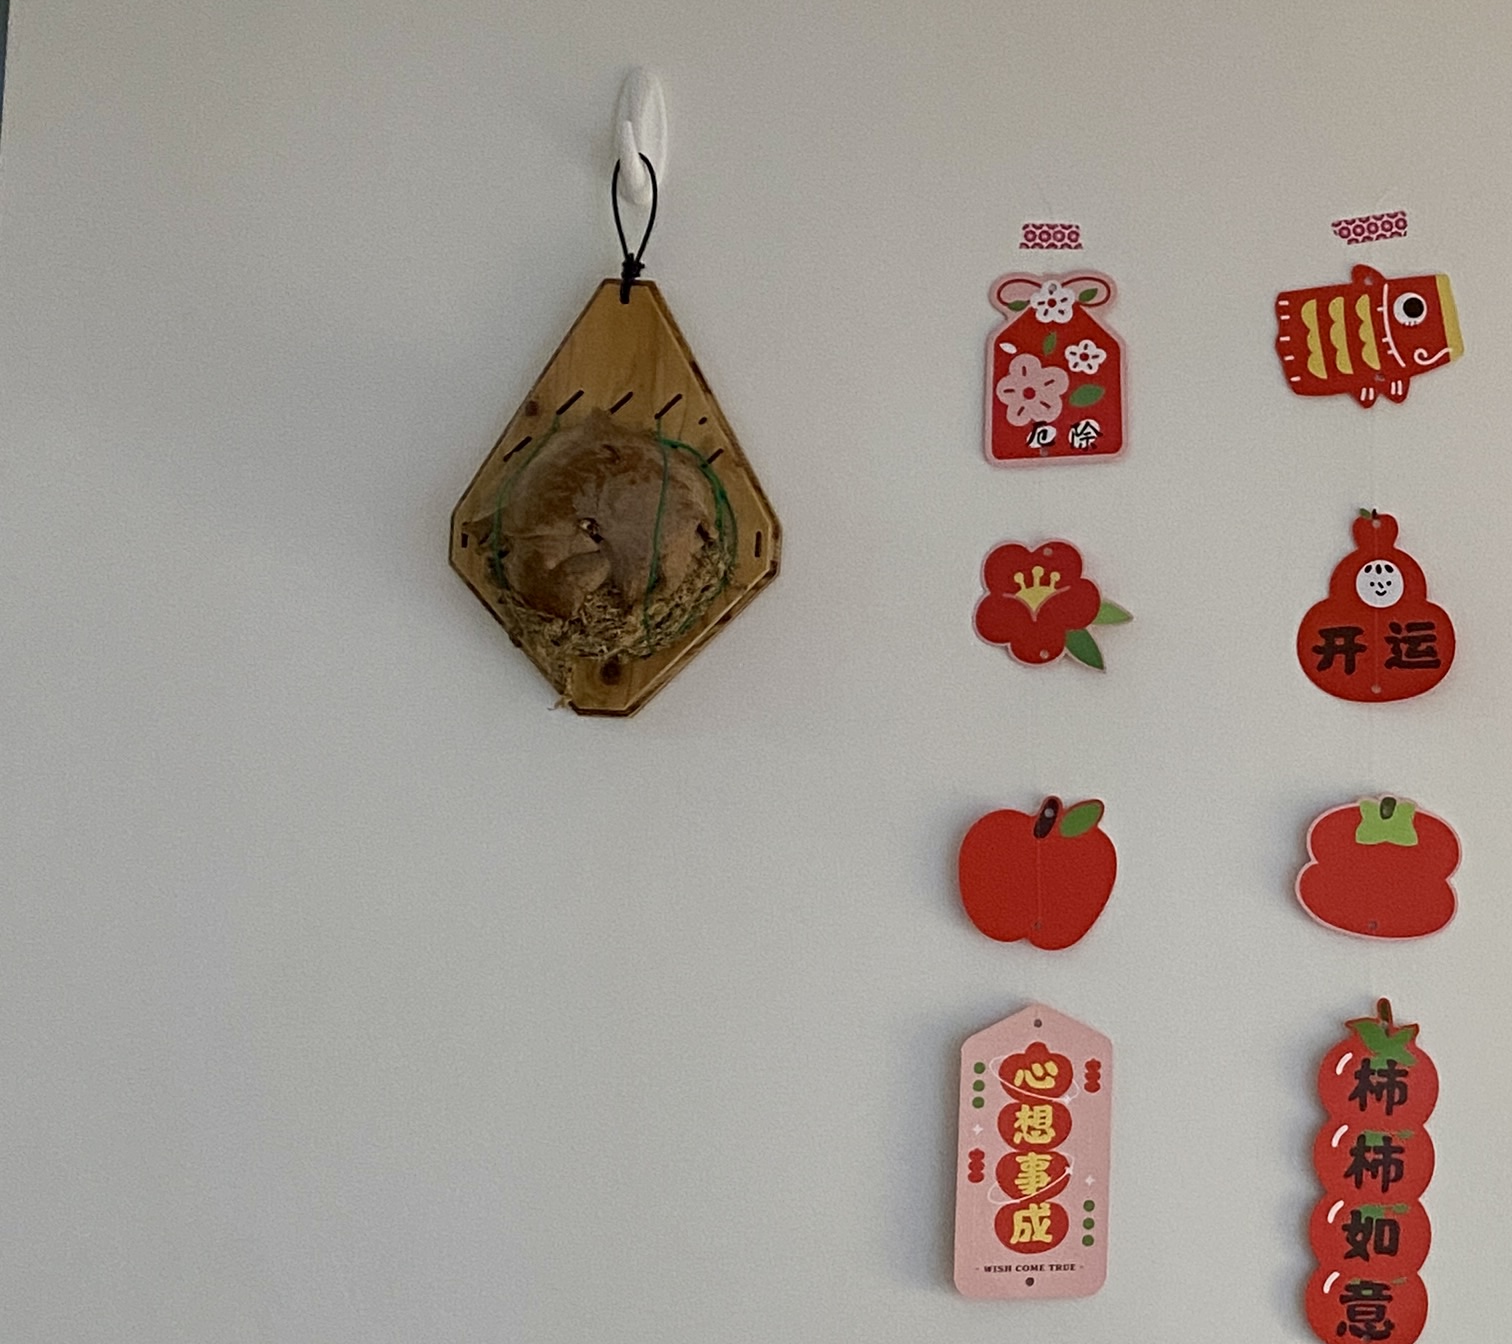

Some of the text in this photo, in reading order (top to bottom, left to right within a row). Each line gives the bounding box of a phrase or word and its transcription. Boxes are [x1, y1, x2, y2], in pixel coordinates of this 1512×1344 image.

[1312, 621, 1441, 675] 开运
[1010, 1060, 1059, 1245] 心想事成
[1335, 1057, 1409, 1340] 柿柿如意
[983, 1263, 1076, 1273] WISH COME TRUE
